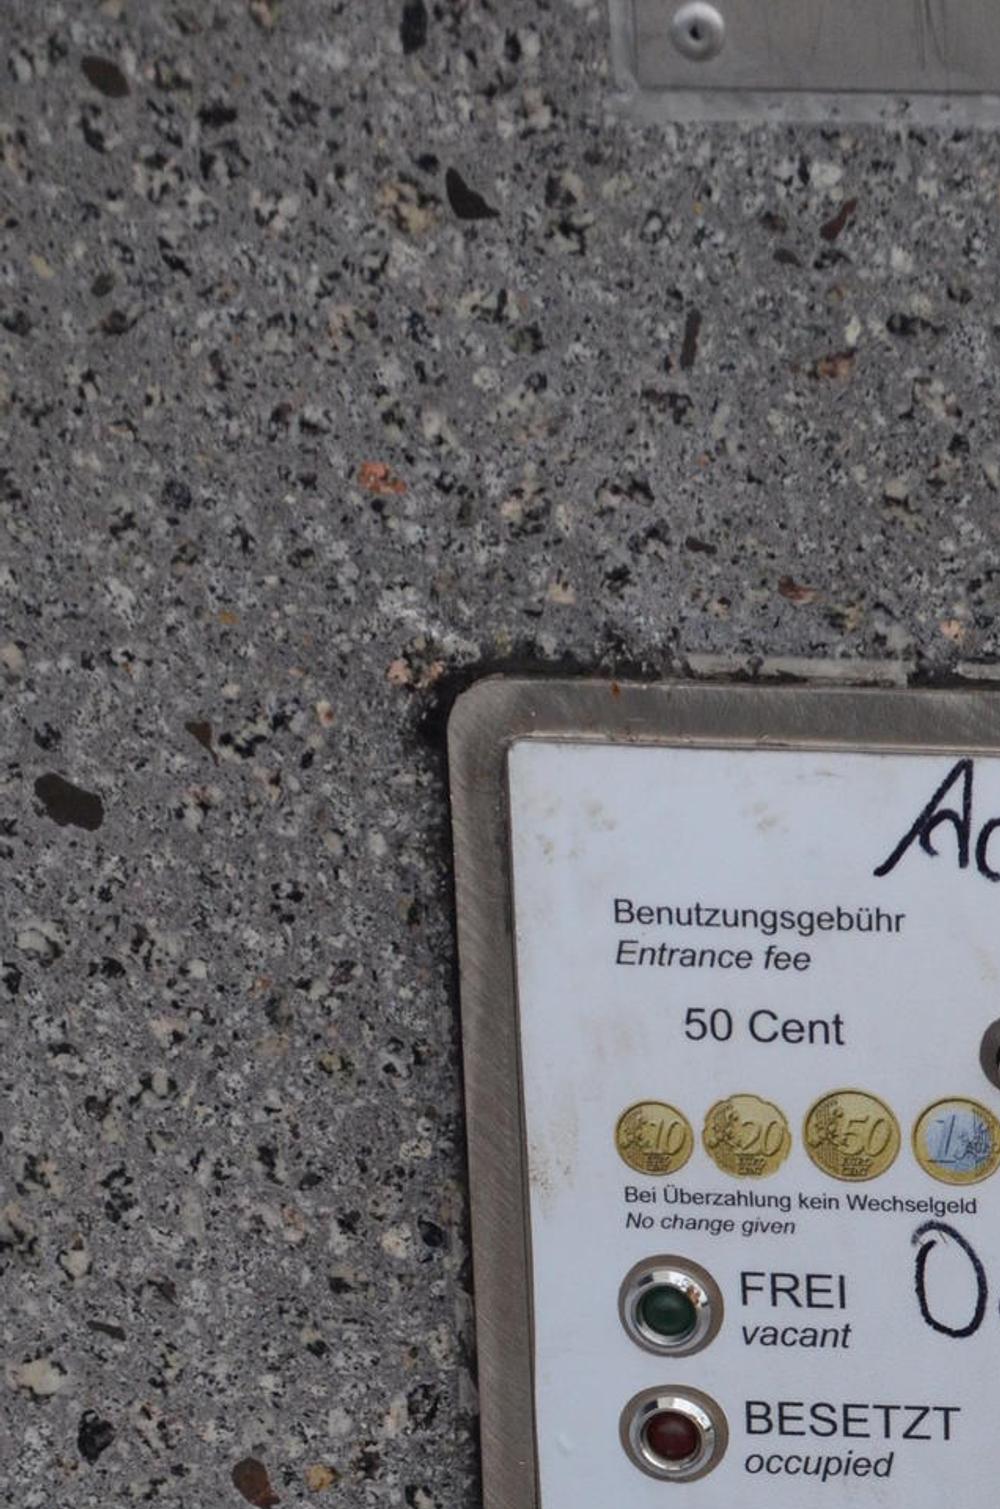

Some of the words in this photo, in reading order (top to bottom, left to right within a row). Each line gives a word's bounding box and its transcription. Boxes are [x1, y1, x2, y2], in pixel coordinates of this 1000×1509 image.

[613, 898, 906, 936] Benutzungsgebühr
[615, 940, 754, 970] Entrance
[763, 945, 812, 971] fee
[684, 1008, 733, 1042] 50
[748, 1010, 846, 1046] Cent
[648, 1119, 687, 1156] 10
[737, 1119, 785, 1157] 20
[842, 1115, 893, 1157] 50
[624, 1186, 657, 1204] Bei
[663, 1184, 792, 1212] Überzahlung
[798, 1192, 840, 1211] kein
[847, 1194, 977, 1216] Wechselgeld
[625, 1212, 654, 1229] No
[660, 1213, 735, 1235] change
[741, 1217, 796, 1237] given
[740, 1271, 846, 1309] FREI
[741, 1324, 852, 1348] vacant
[745, 1400, 961, 1441] BESETZT
[744, 1450, 894, 1482] occupied
